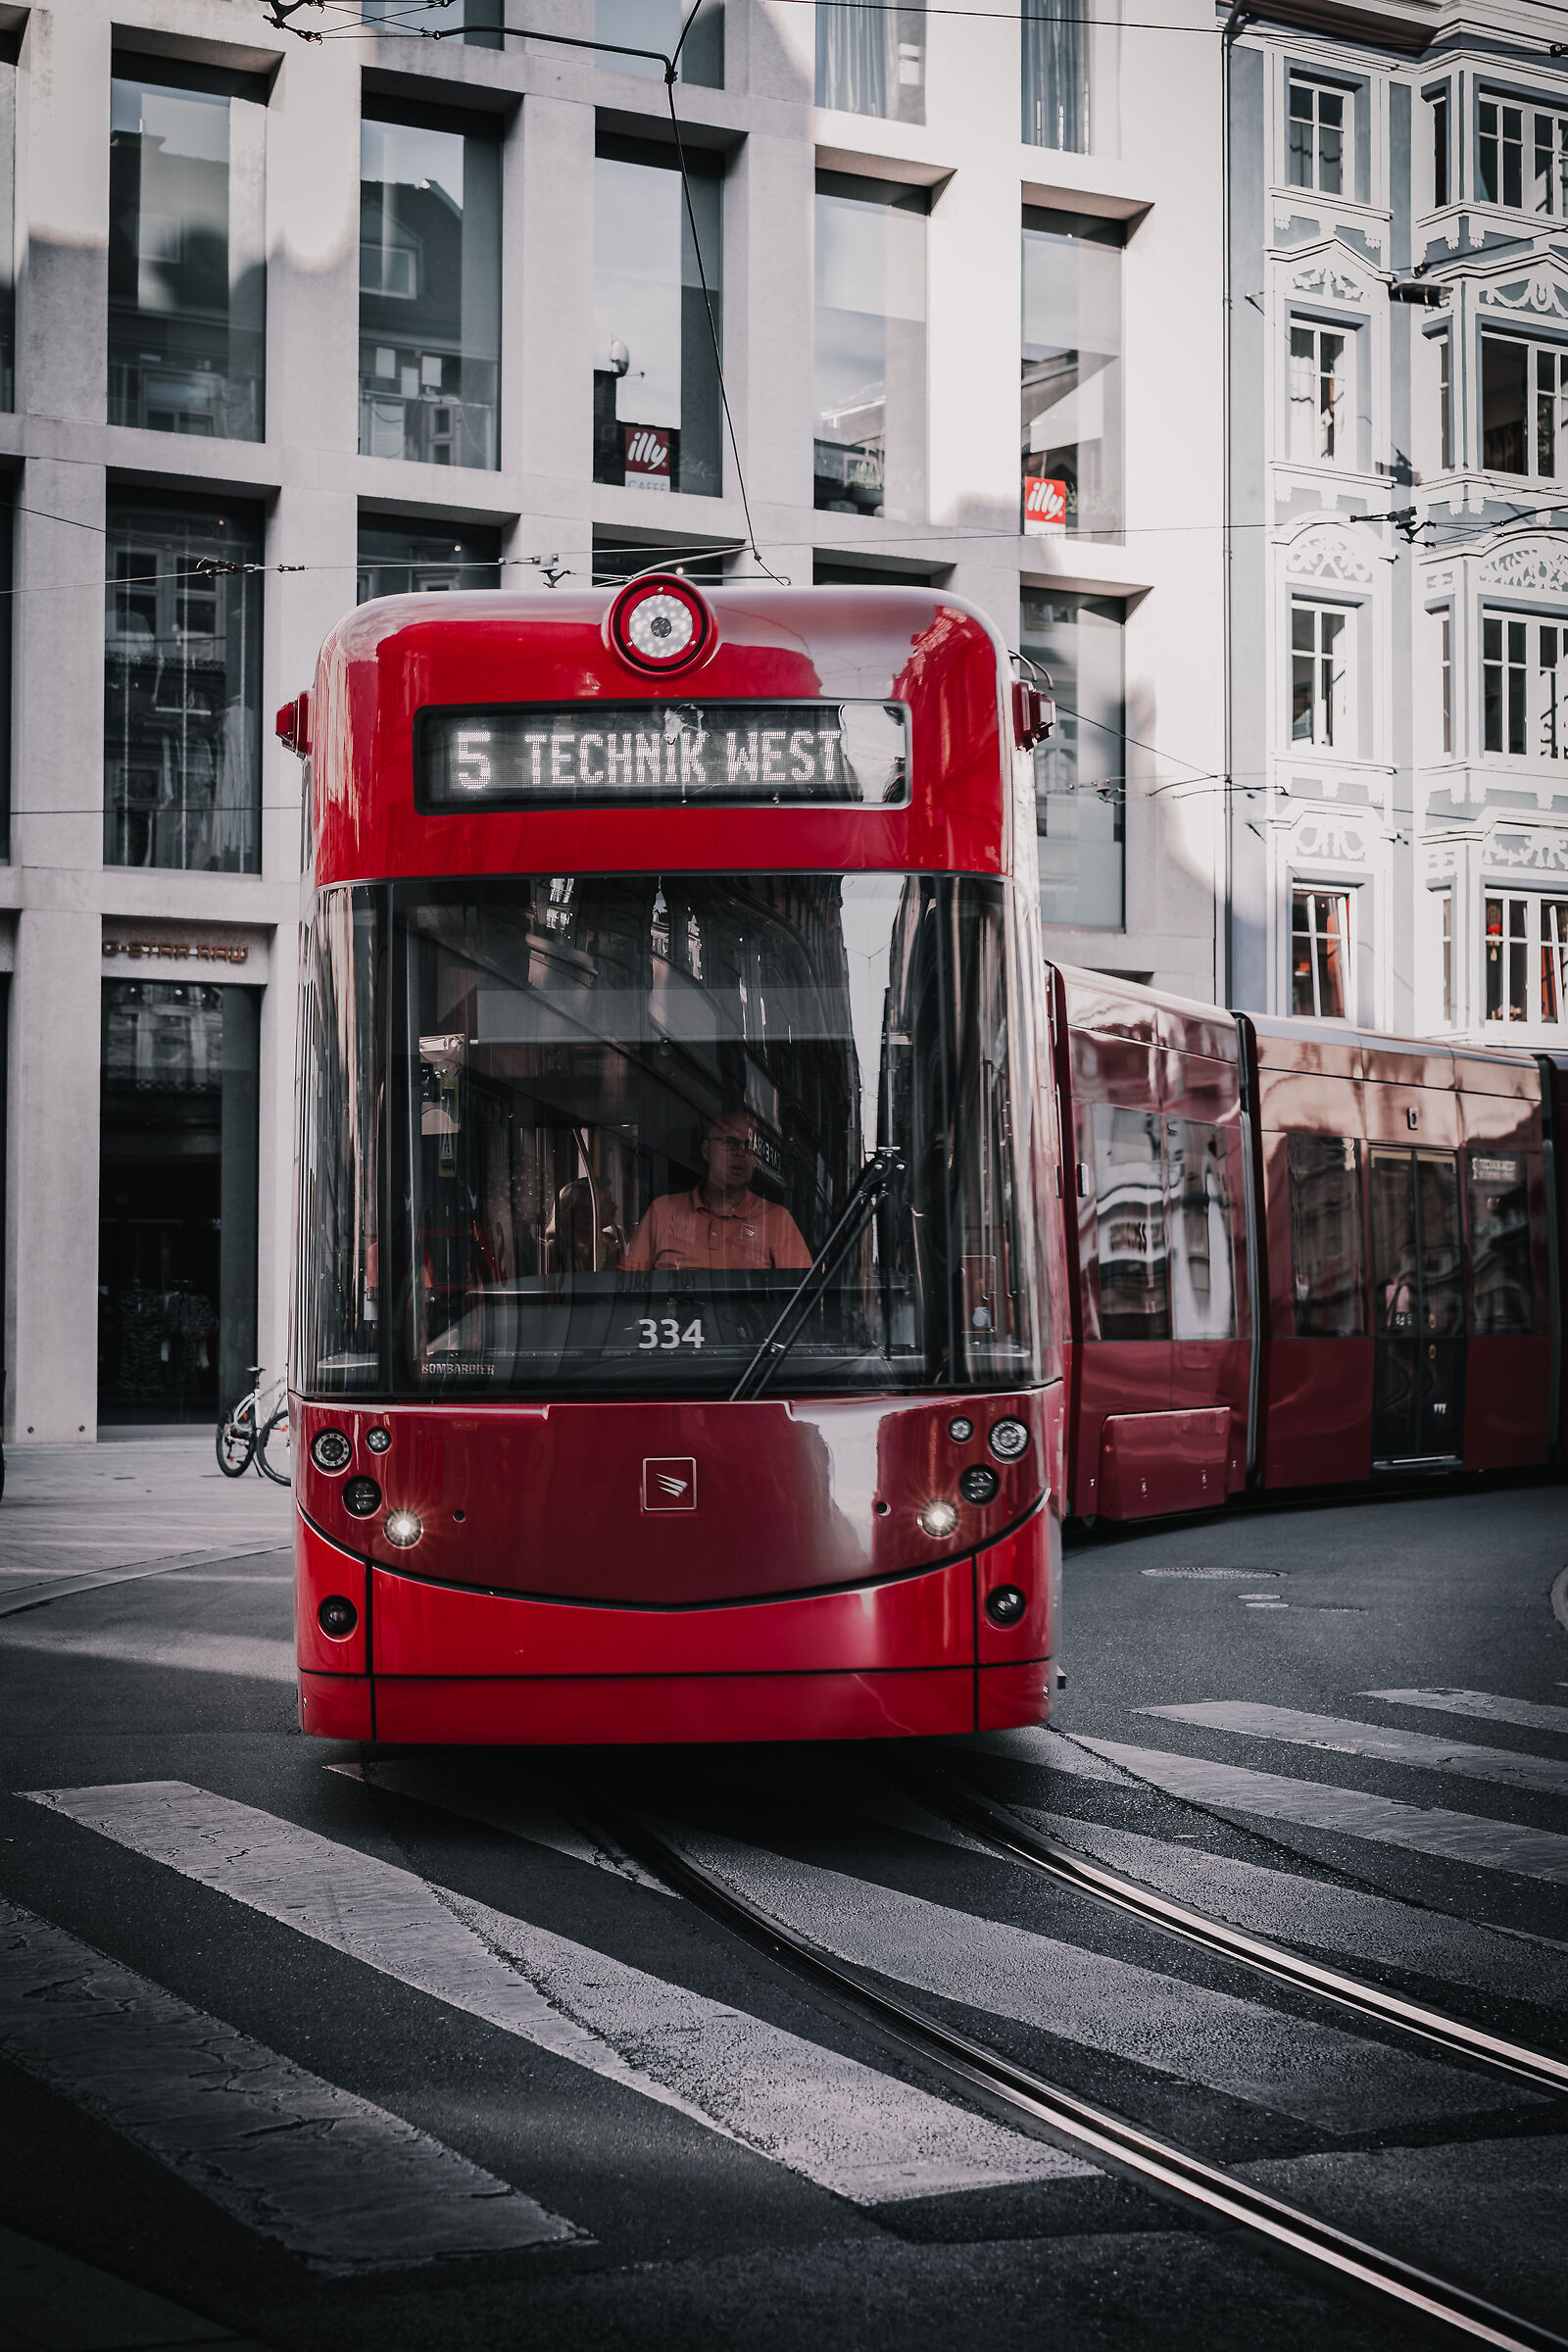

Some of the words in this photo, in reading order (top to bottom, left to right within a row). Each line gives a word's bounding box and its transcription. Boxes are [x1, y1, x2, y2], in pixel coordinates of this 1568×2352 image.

[627, 431, 667, 470] illy
[1027, 481, 1064, 520] illy
[458, 731, 491, 790] 5
[524, 732, 707, 785] TECHNIK
[726, 729, 841, 782] WEST
[197, 944, 249, 964] RAW
[638, 1318, 706, 1349] 334
[421, 1363, 495, 1376] BOMBARDIER
